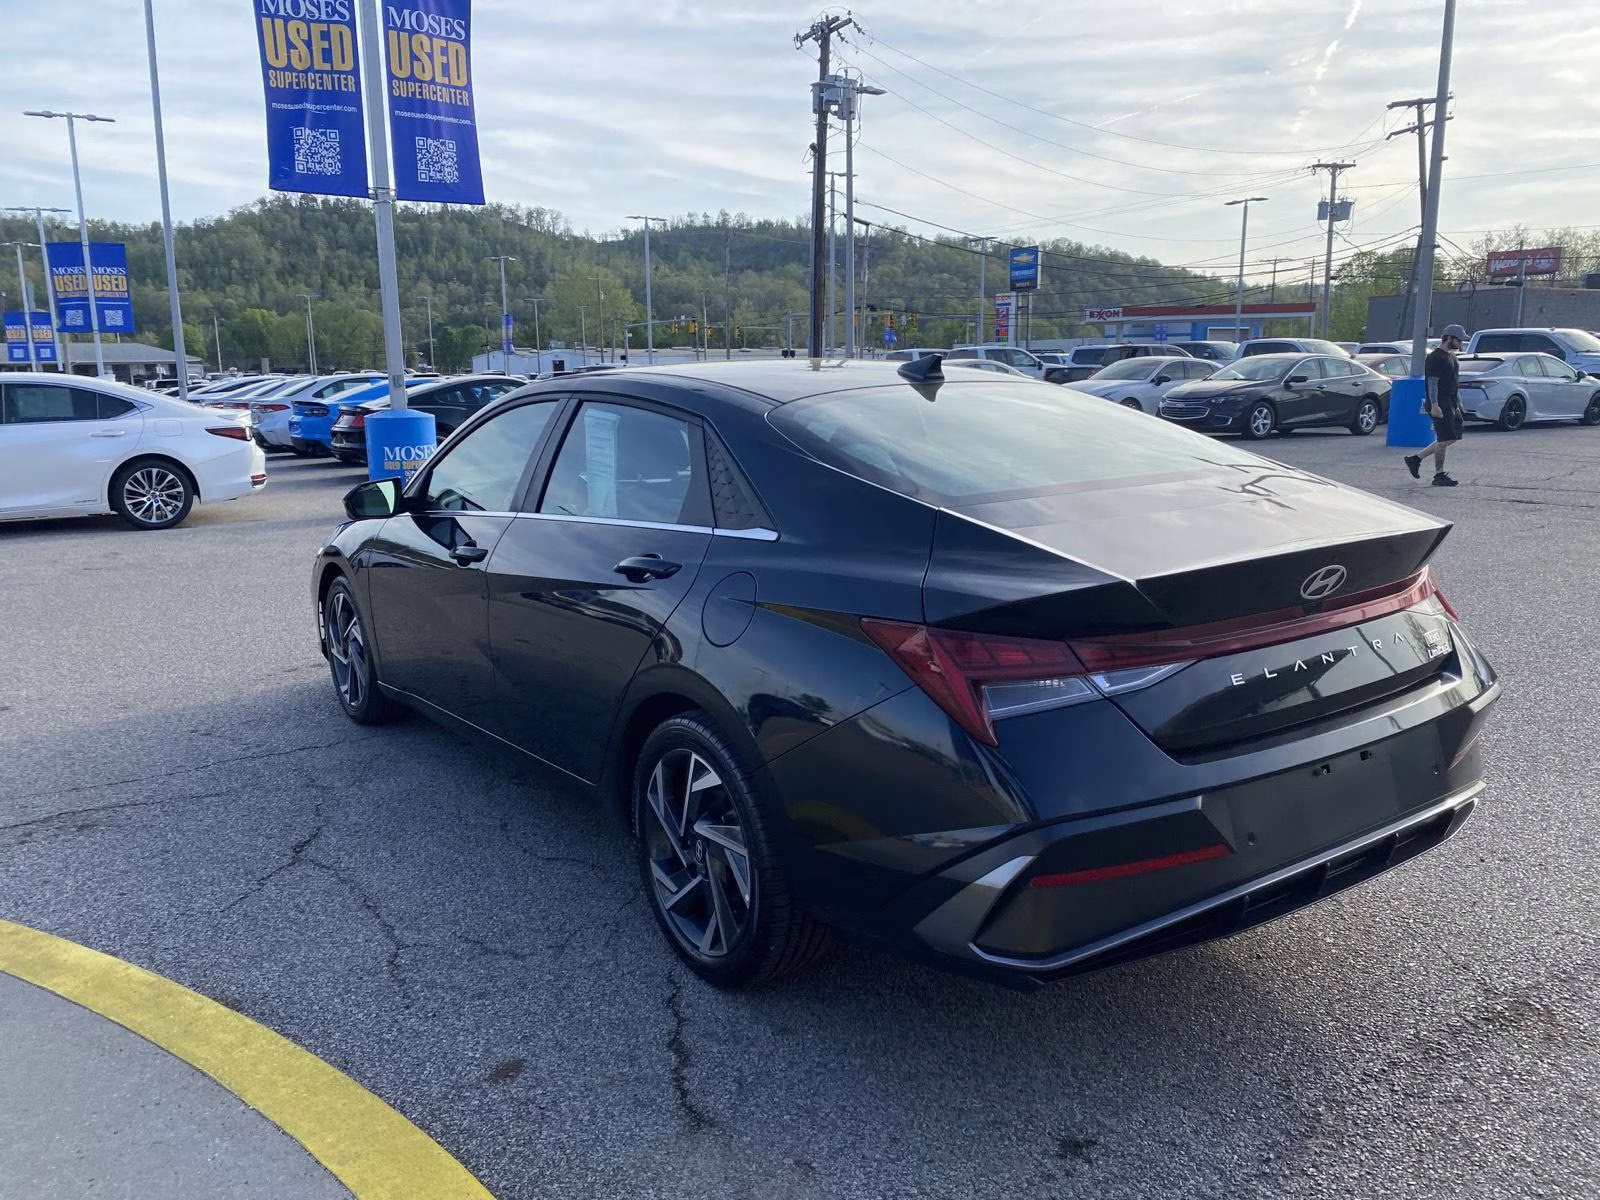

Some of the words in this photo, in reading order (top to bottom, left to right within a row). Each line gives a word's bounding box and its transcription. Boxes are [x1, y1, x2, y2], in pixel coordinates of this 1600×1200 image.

[260, 0, 350, 22] MOSES
[387, 6, 465, 40] MOSES
[262, 17, 353, 71] USED
[389, 30, 467, 86] USED
[268, 70, 356, 93] SUPERCENTER
[392, 80, 469, 106] SUPERCENTER
[271, 101, 358, 113] mosesusedsupercenter.com
[394, 110, 472, 125] mosesusedsupercenter.com
[53, 267, 85, 275] MOSES
[92, 267, 125, 275] MOSES
[54, 275, 88, 292] USED
[93, 275, 128, 292] USED
[1089, 309, 1120, 320] EXXON
[1230, 632, 1404, 686] ELANTRA
